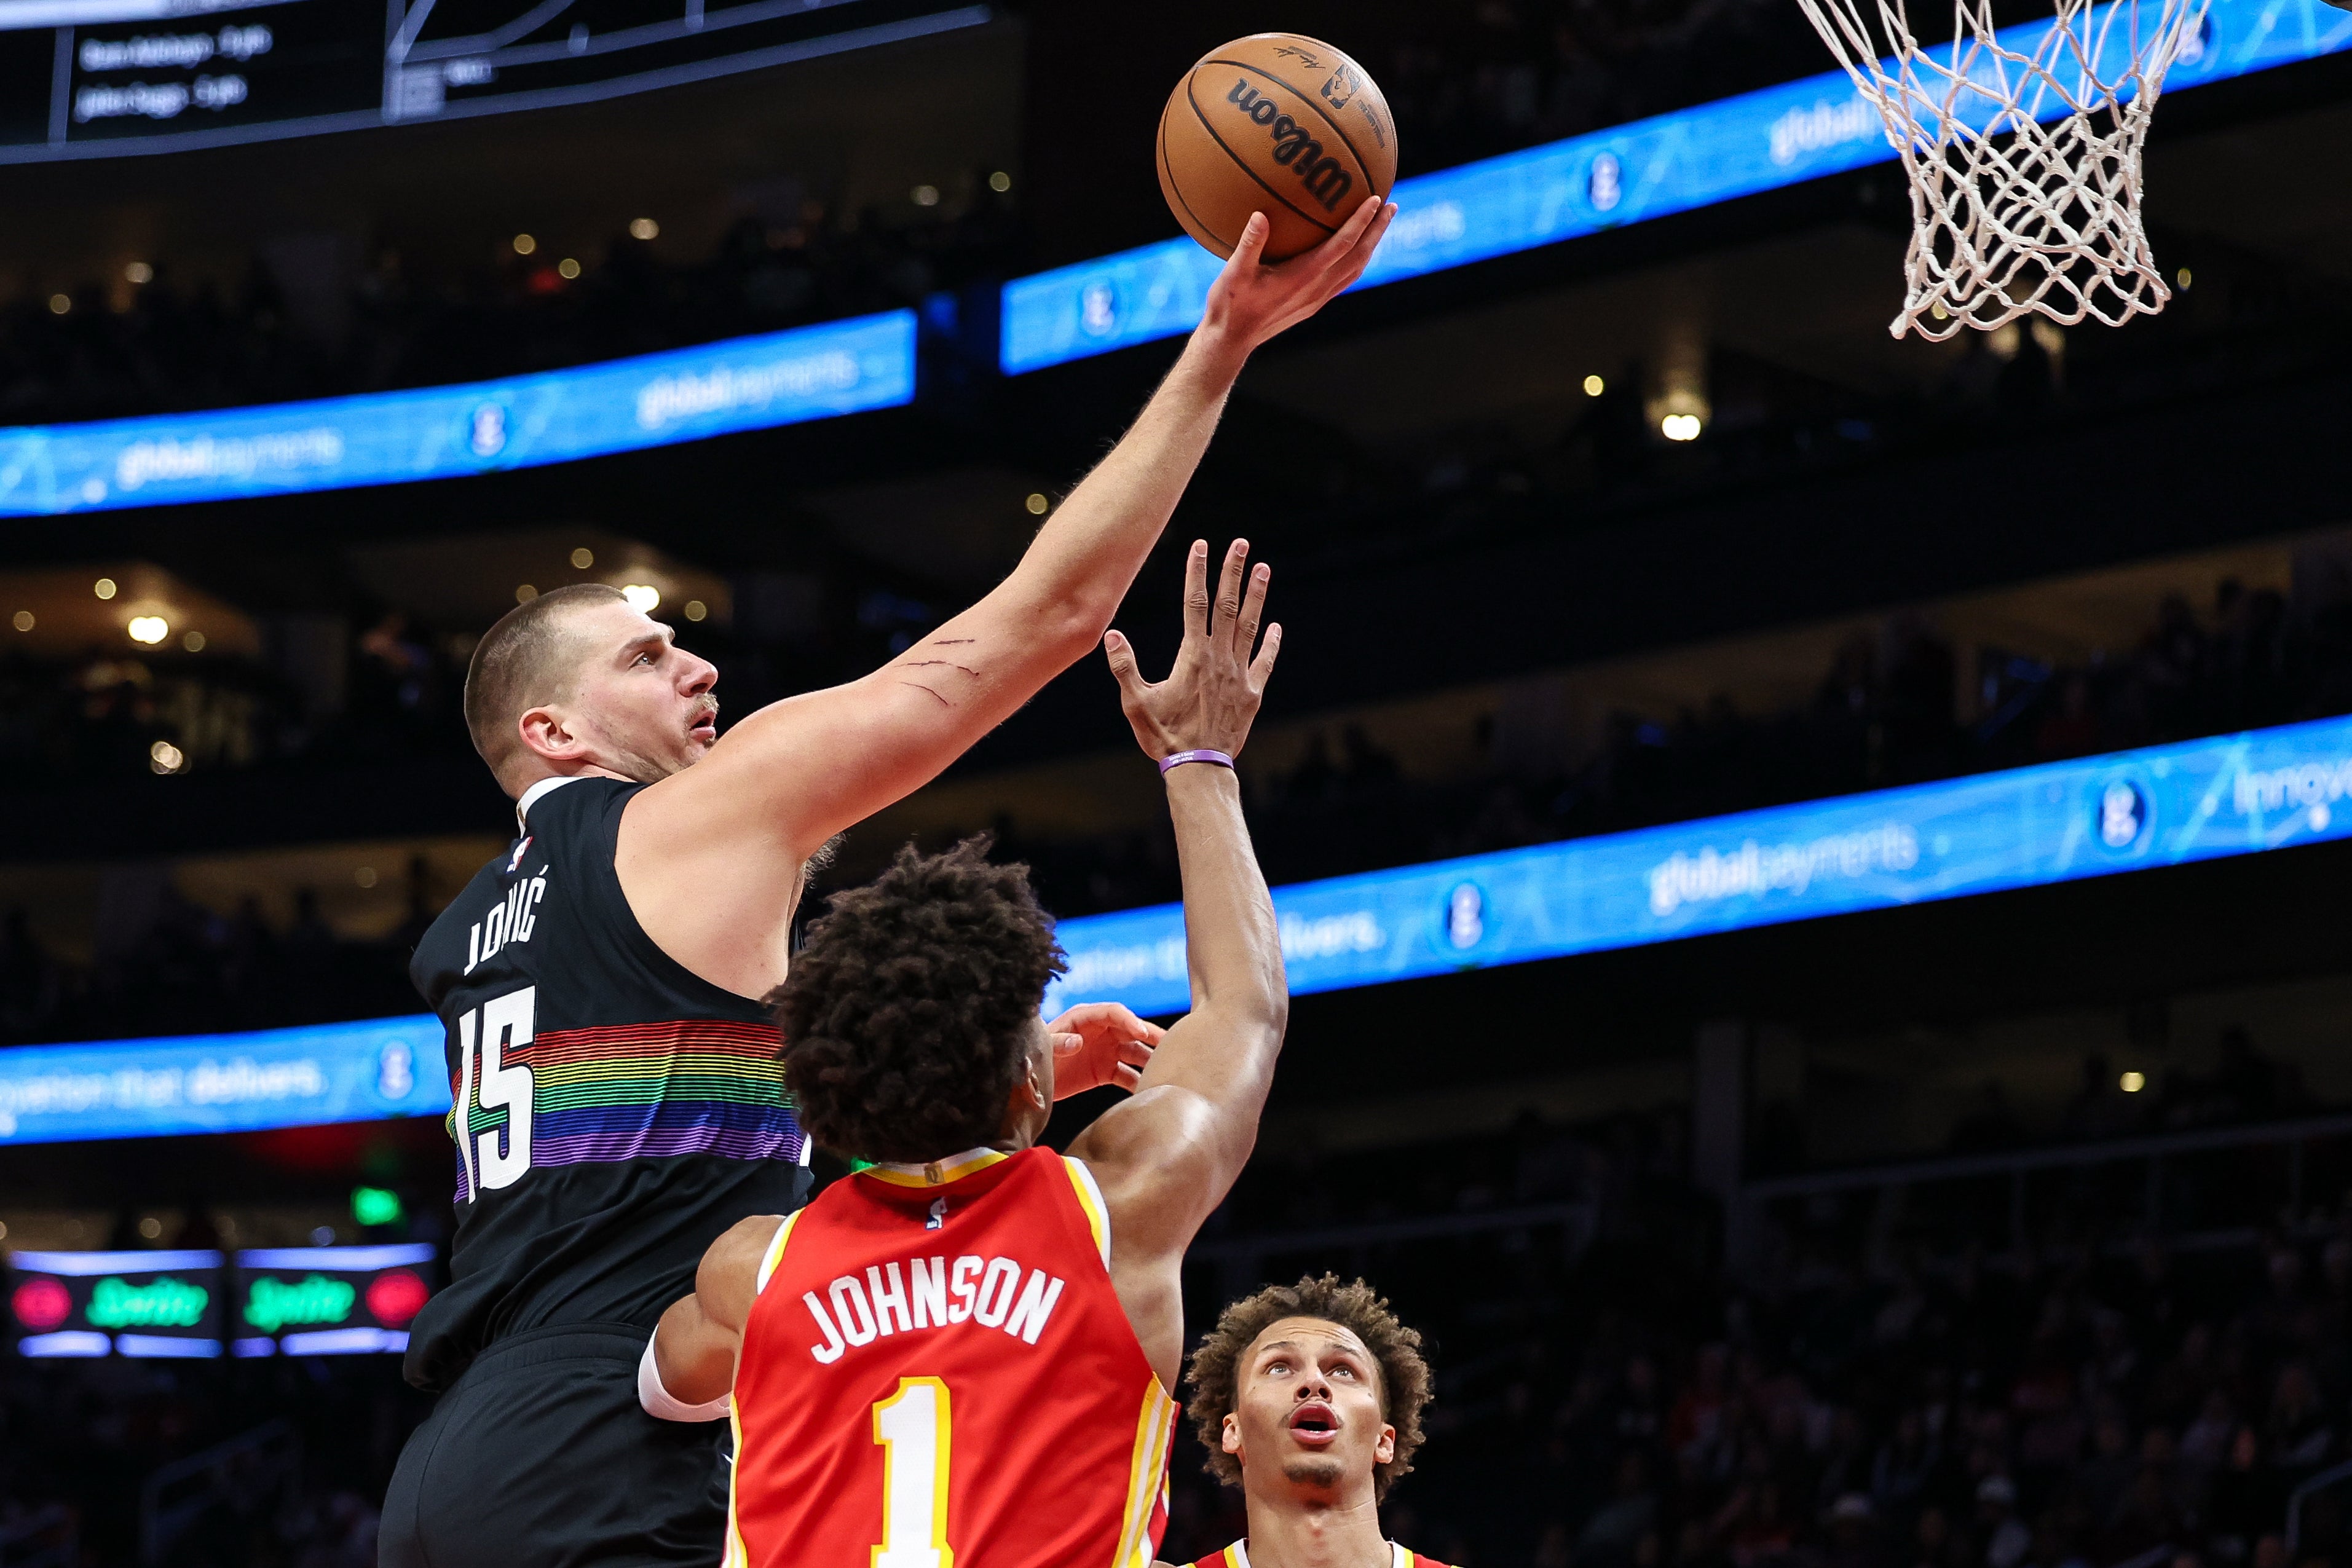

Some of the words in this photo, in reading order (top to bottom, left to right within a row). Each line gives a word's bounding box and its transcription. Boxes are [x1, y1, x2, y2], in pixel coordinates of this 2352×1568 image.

[1227, 77, 1352, 213] Wilson
[2233, 757, 2352, 816] Innov
[455, 985, 536, 1205] 15
[802, 1254, 1065, 1365] JOHNSON
[870, 1376, 953, 1568] 1
